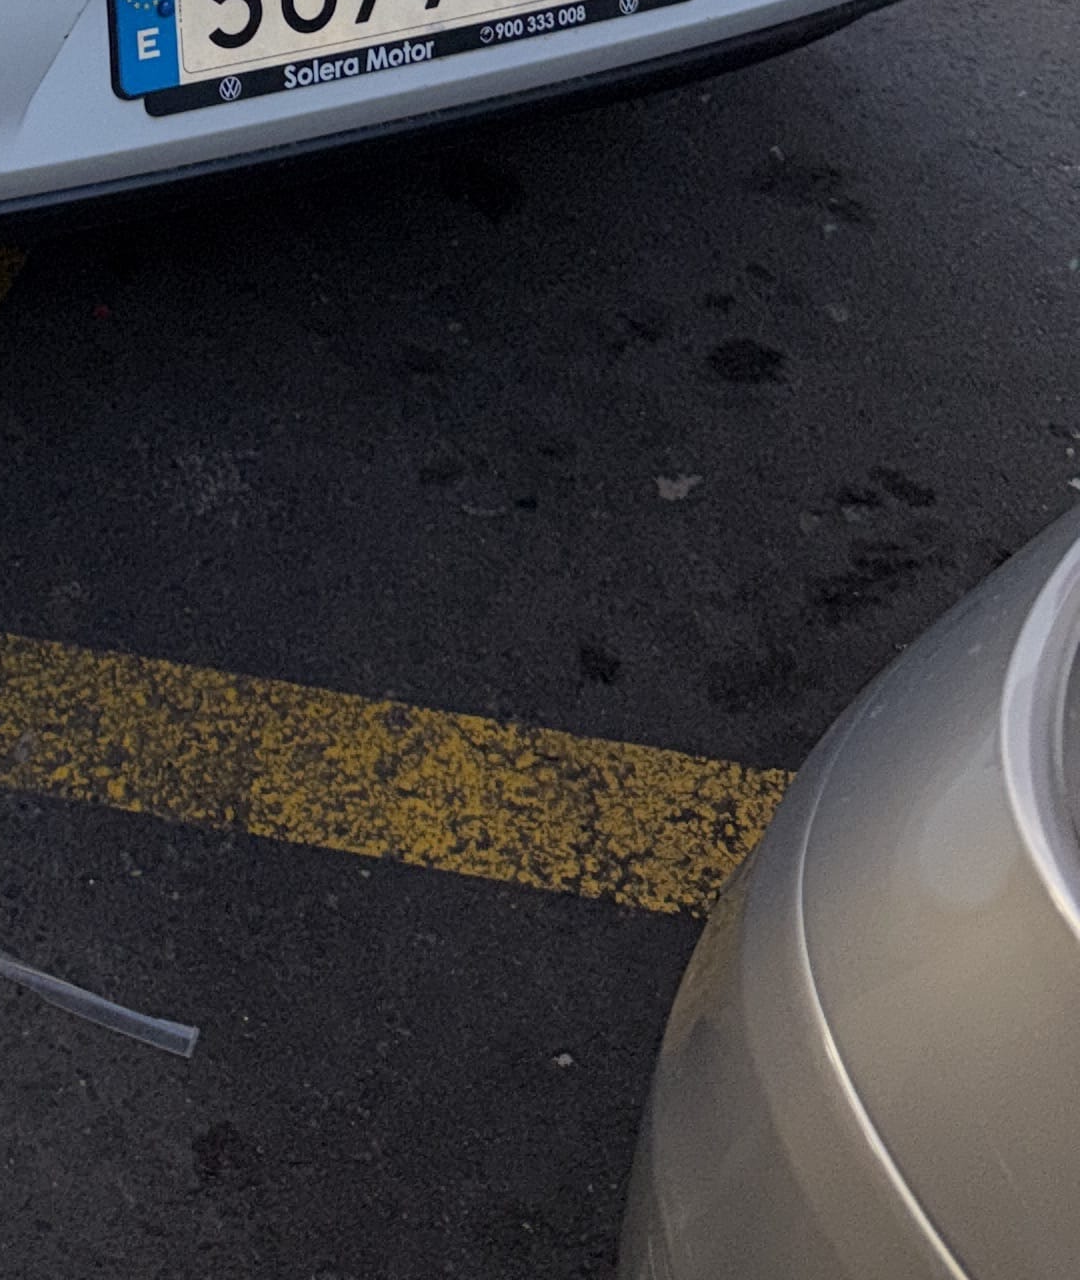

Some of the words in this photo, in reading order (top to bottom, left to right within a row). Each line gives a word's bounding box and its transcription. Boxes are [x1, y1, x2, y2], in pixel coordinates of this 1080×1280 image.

[136, 27, 161, 61] E
[283, 58, 360, 89] Solera
[366, 39, 435, 73] Motor
[495, 19, 524, 40] 900
[527, 12, 555, 33] 333
[558, 5, 587, 27] 008
